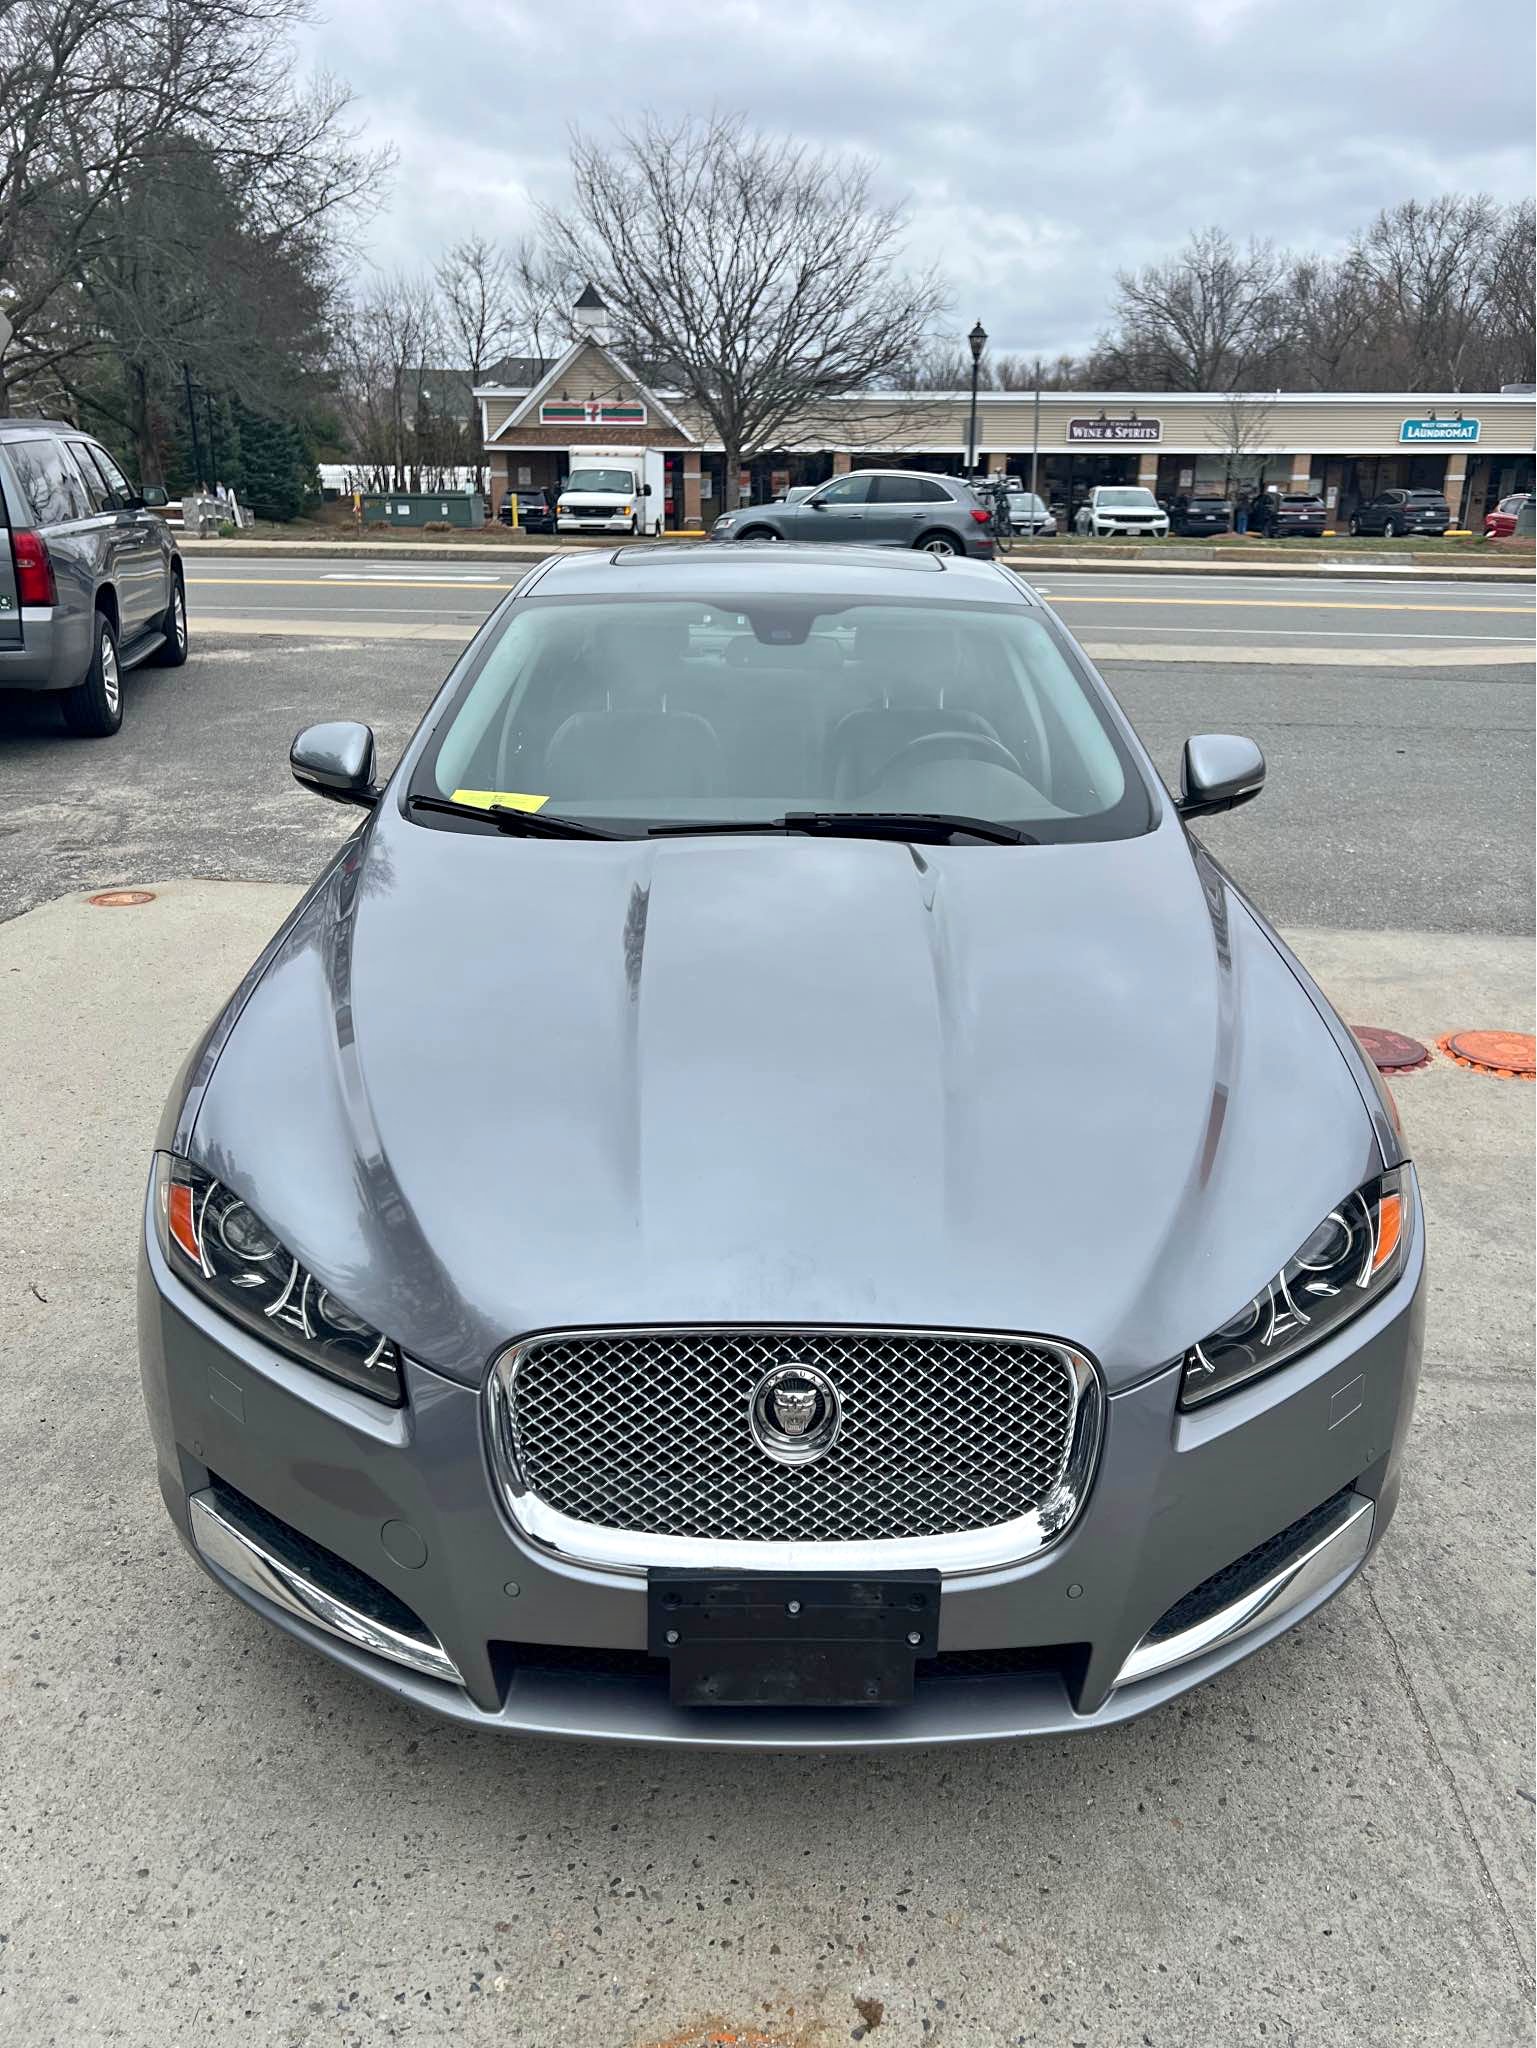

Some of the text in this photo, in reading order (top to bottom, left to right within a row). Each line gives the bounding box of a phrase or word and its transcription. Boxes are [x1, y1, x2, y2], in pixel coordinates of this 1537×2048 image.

[1072, 426, 1158, 438] WINE & SPIRITS
[1407, 426, 1475, 438] LAUNDROMAT
